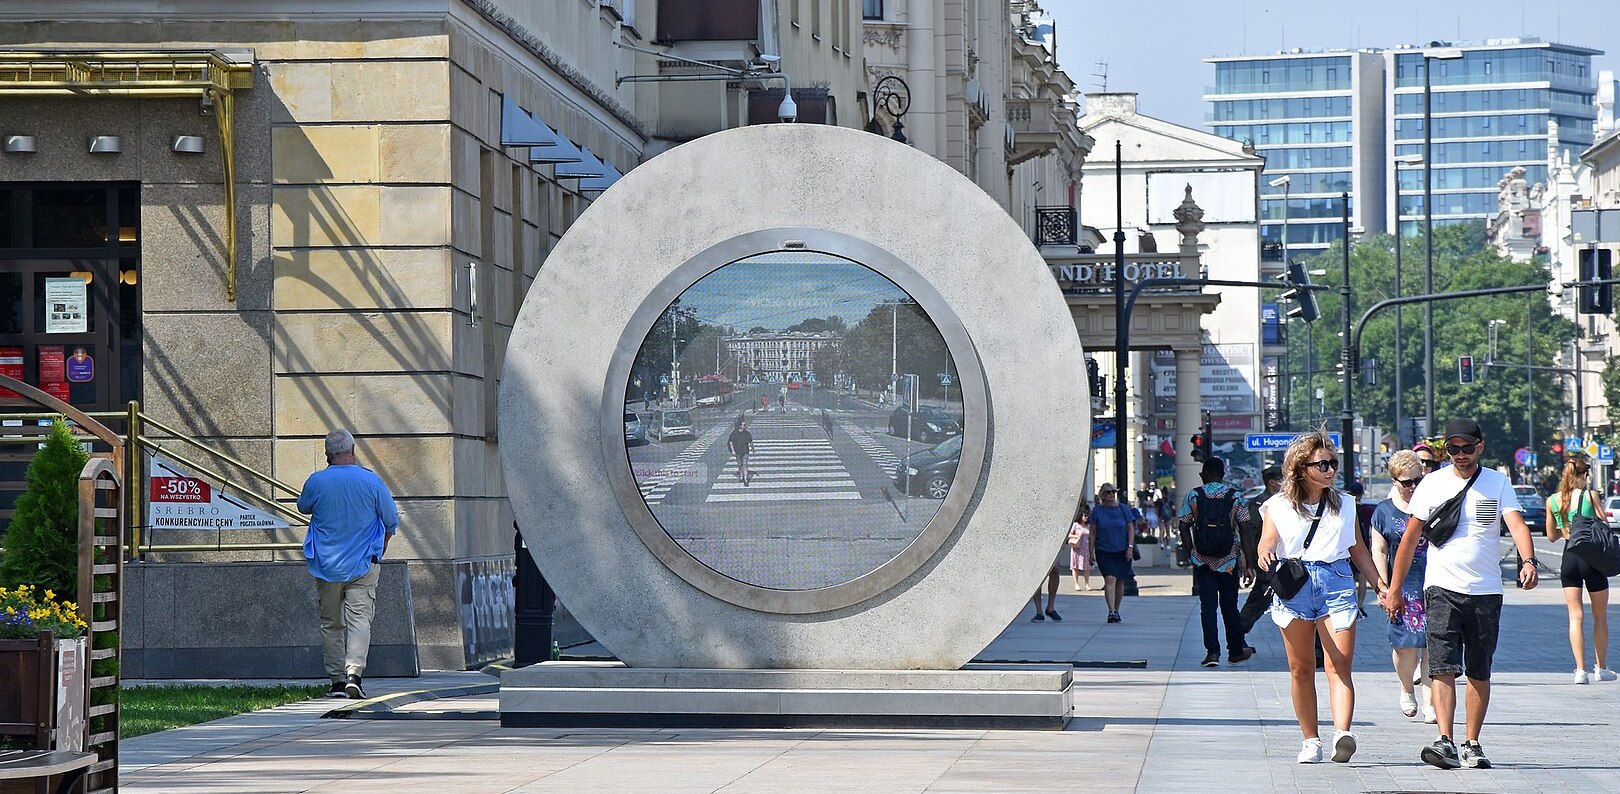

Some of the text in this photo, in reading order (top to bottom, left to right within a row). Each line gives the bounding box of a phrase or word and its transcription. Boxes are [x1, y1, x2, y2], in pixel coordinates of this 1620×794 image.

[1056, 263, 1187, 281] ND HOTEL
[1251, 438, 1261, 447] ul.
[160, 480, 201, 494] -50%
[155, 506, 219, 516] SREBRO
[155, 517, 234, 527] KONKURENCYJNE CENY
